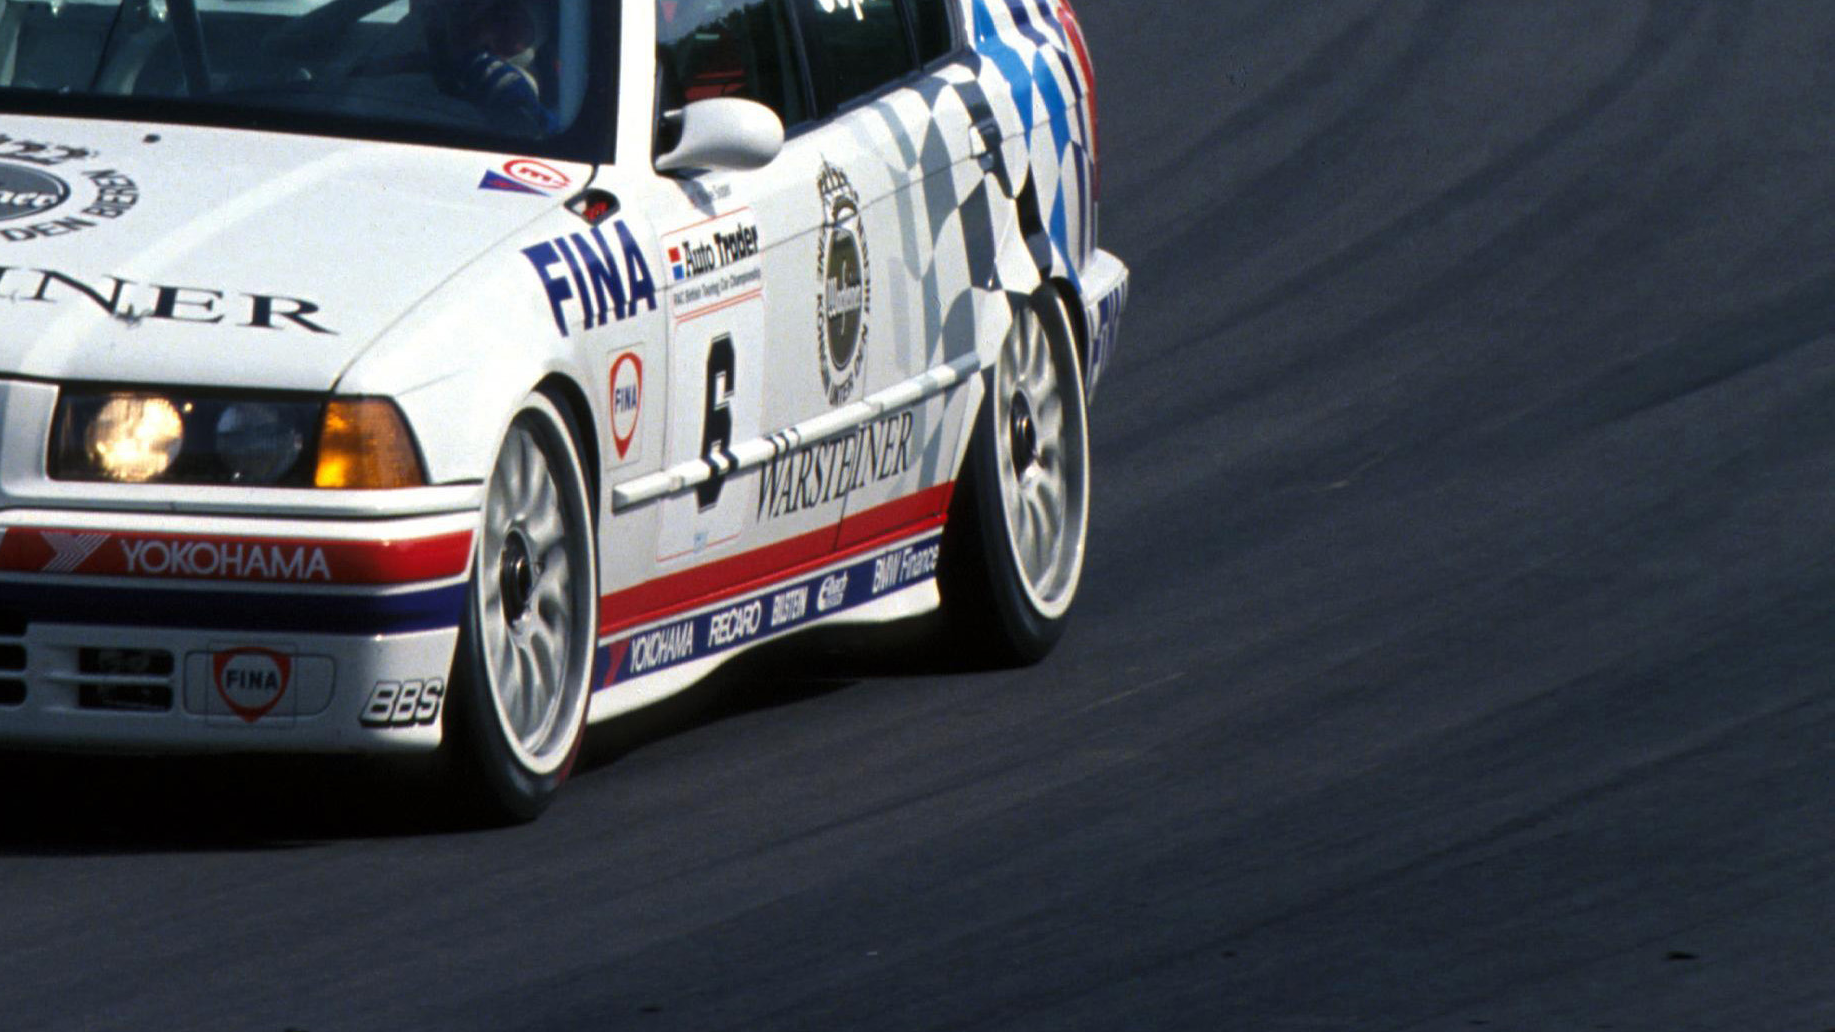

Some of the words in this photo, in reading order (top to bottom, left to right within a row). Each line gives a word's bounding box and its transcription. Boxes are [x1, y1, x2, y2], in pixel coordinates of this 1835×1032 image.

[682, 240, 715, 279] Auto
[713, 222, 759, 267] Trader
[520, 220, 657, 337] FINA
[614, 384, 638, 411] FINA
[756, 410, 915, 525] WARSTEINER
[120, 539, 331, 582] YOKOHAMA
[871, 550, 903, 594] BMW
[899, 543, 940, 584] Finance
[708, 599, 762, 648] RECARO
[771, 586, 809, 627] BILSTEIN
[630, 621, 694, 673] YOKOHAMA
[226, 668, 279, 692] FINA
[358, 677, 444, 729] BBS
